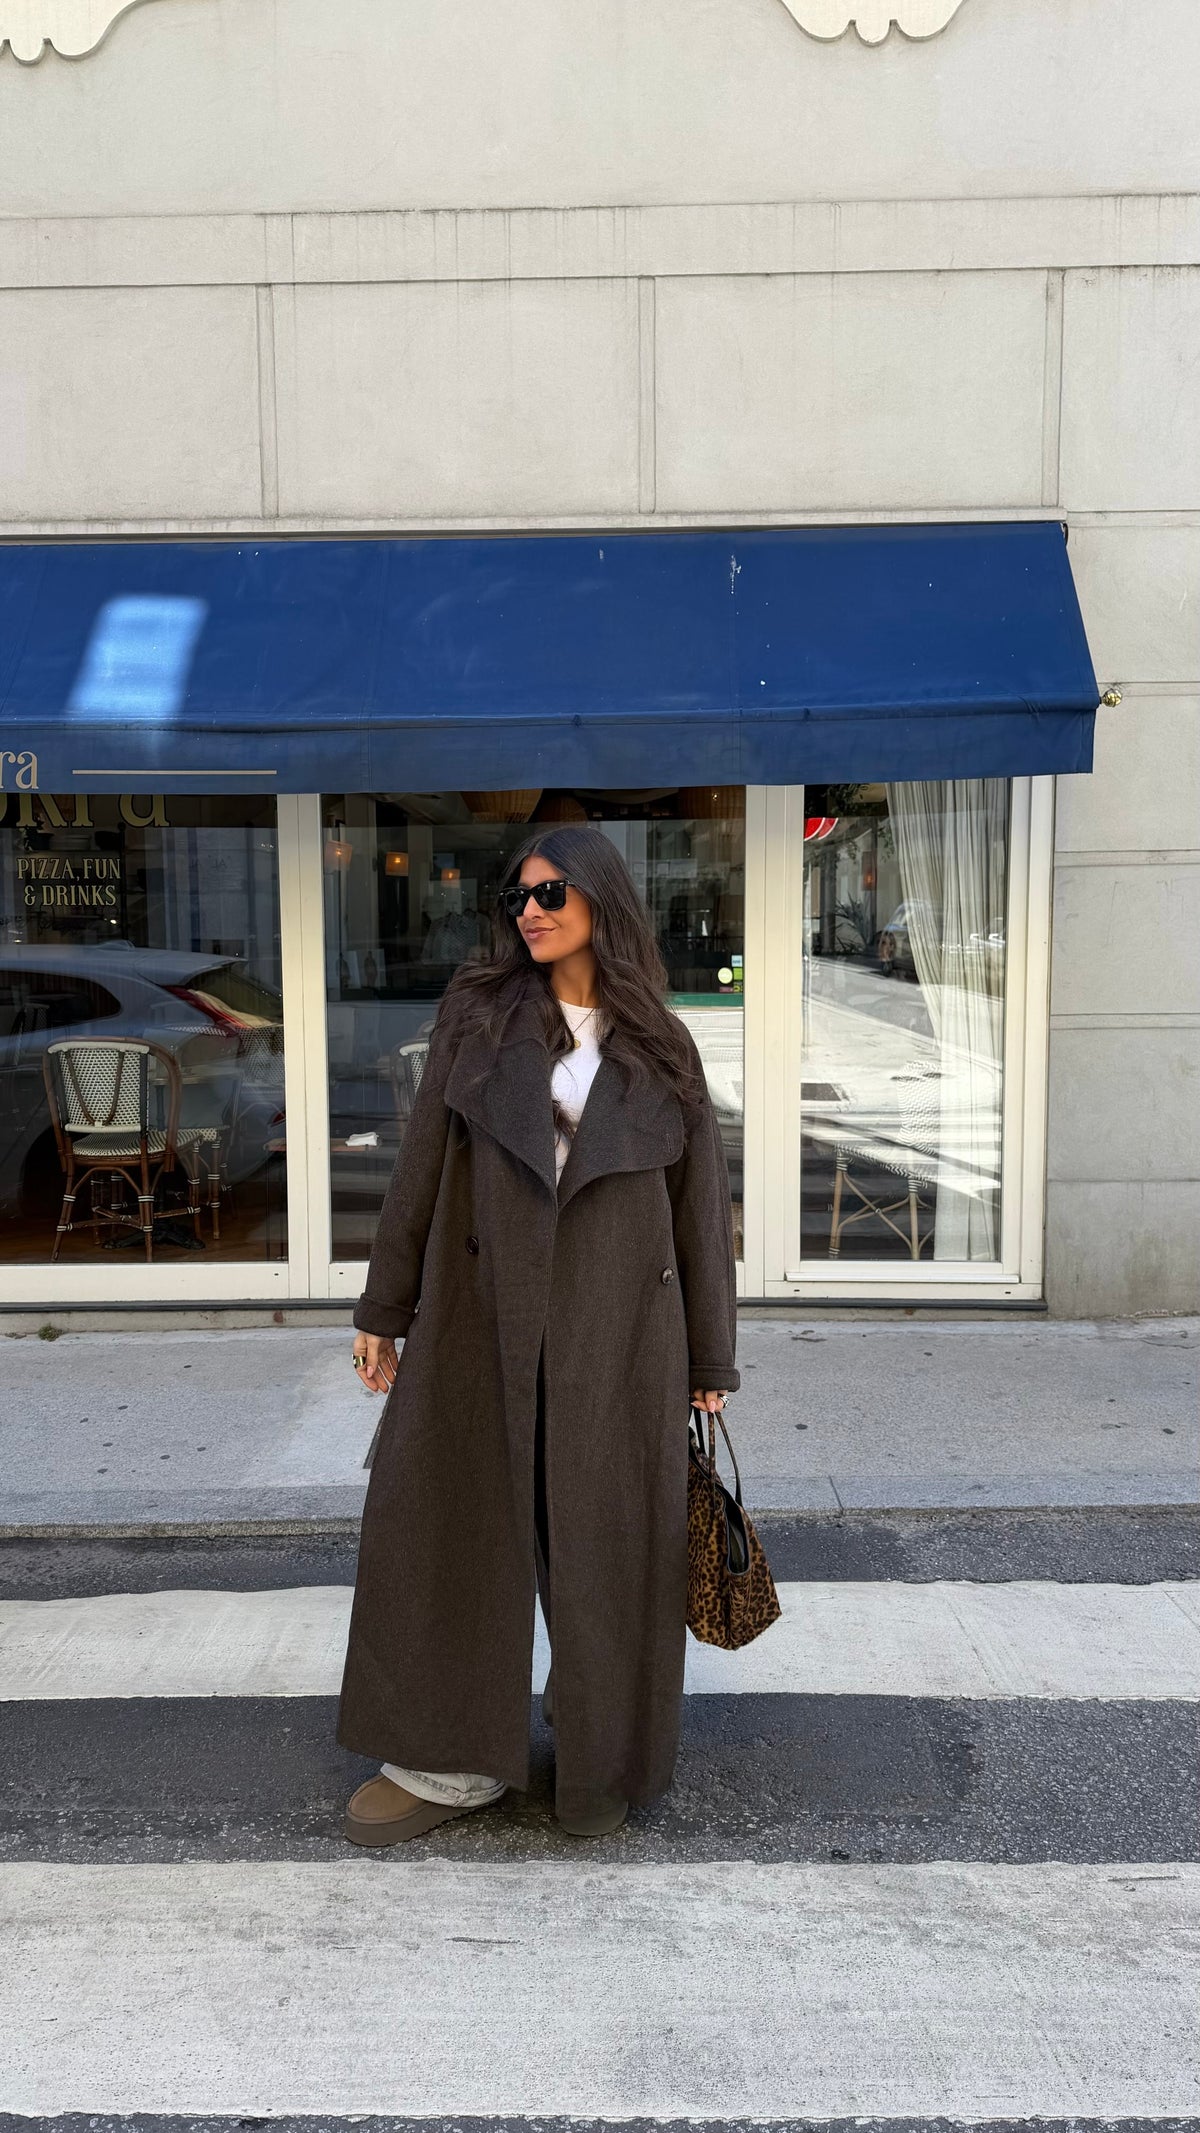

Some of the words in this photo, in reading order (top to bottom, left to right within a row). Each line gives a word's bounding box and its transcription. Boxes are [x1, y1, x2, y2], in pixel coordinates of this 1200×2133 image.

[17, 858, 80, 881] PIZZA,
[83, 858, 121, 879] FUN
[24, 885, 36, 906] &
[42, 885, 116, 906] DRINKS
